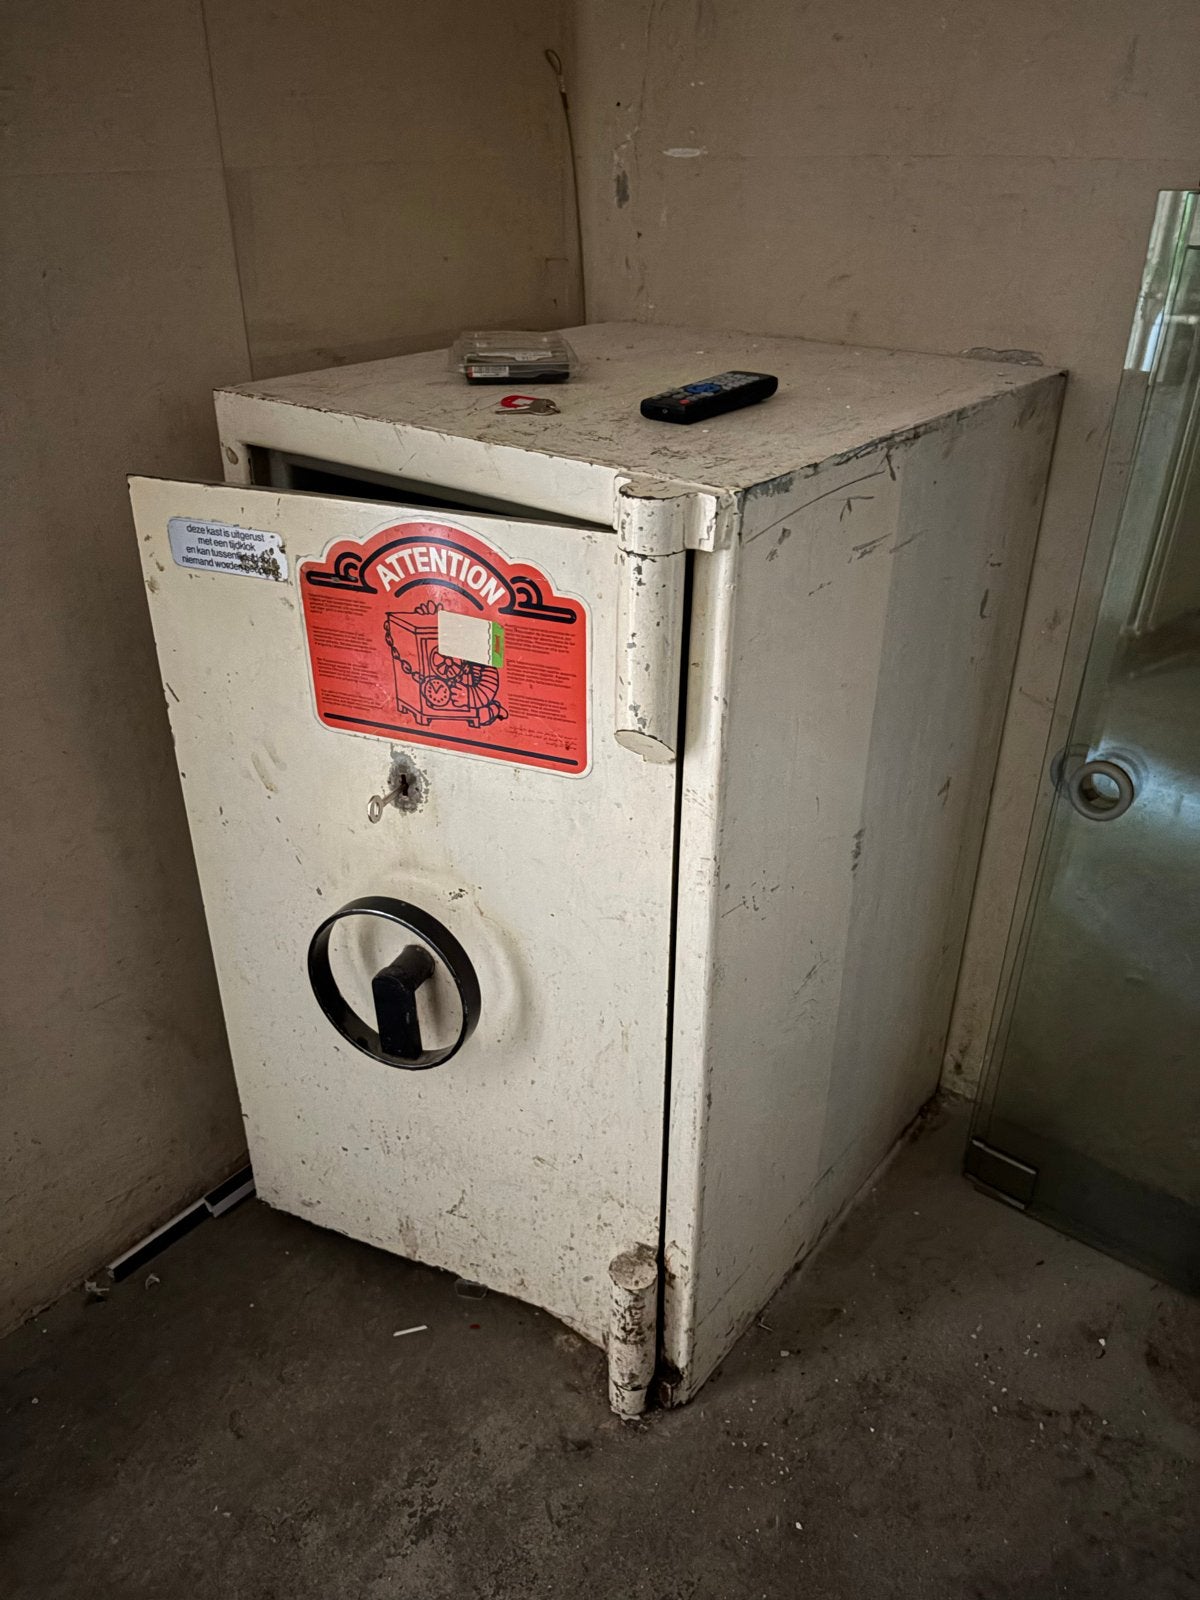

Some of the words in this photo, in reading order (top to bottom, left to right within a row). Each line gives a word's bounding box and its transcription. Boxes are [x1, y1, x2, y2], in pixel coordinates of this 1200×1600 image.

[186, 524, 205, 534] deze
[206, 526, 222, 537] kast
[223, 528, 230, 537] is
[231, 530, 265, 542] uitgerust
[186, 546, 196, 554] en
[196, 546, 211, 556] kan
[198, 537, 213, 546] met
[213, 539, 228, 548] een
[229, 540, 256, 552] tijdklok
[182, 555, 214, 567] niemand
[376, 546, 505, 606] ATTENTION
